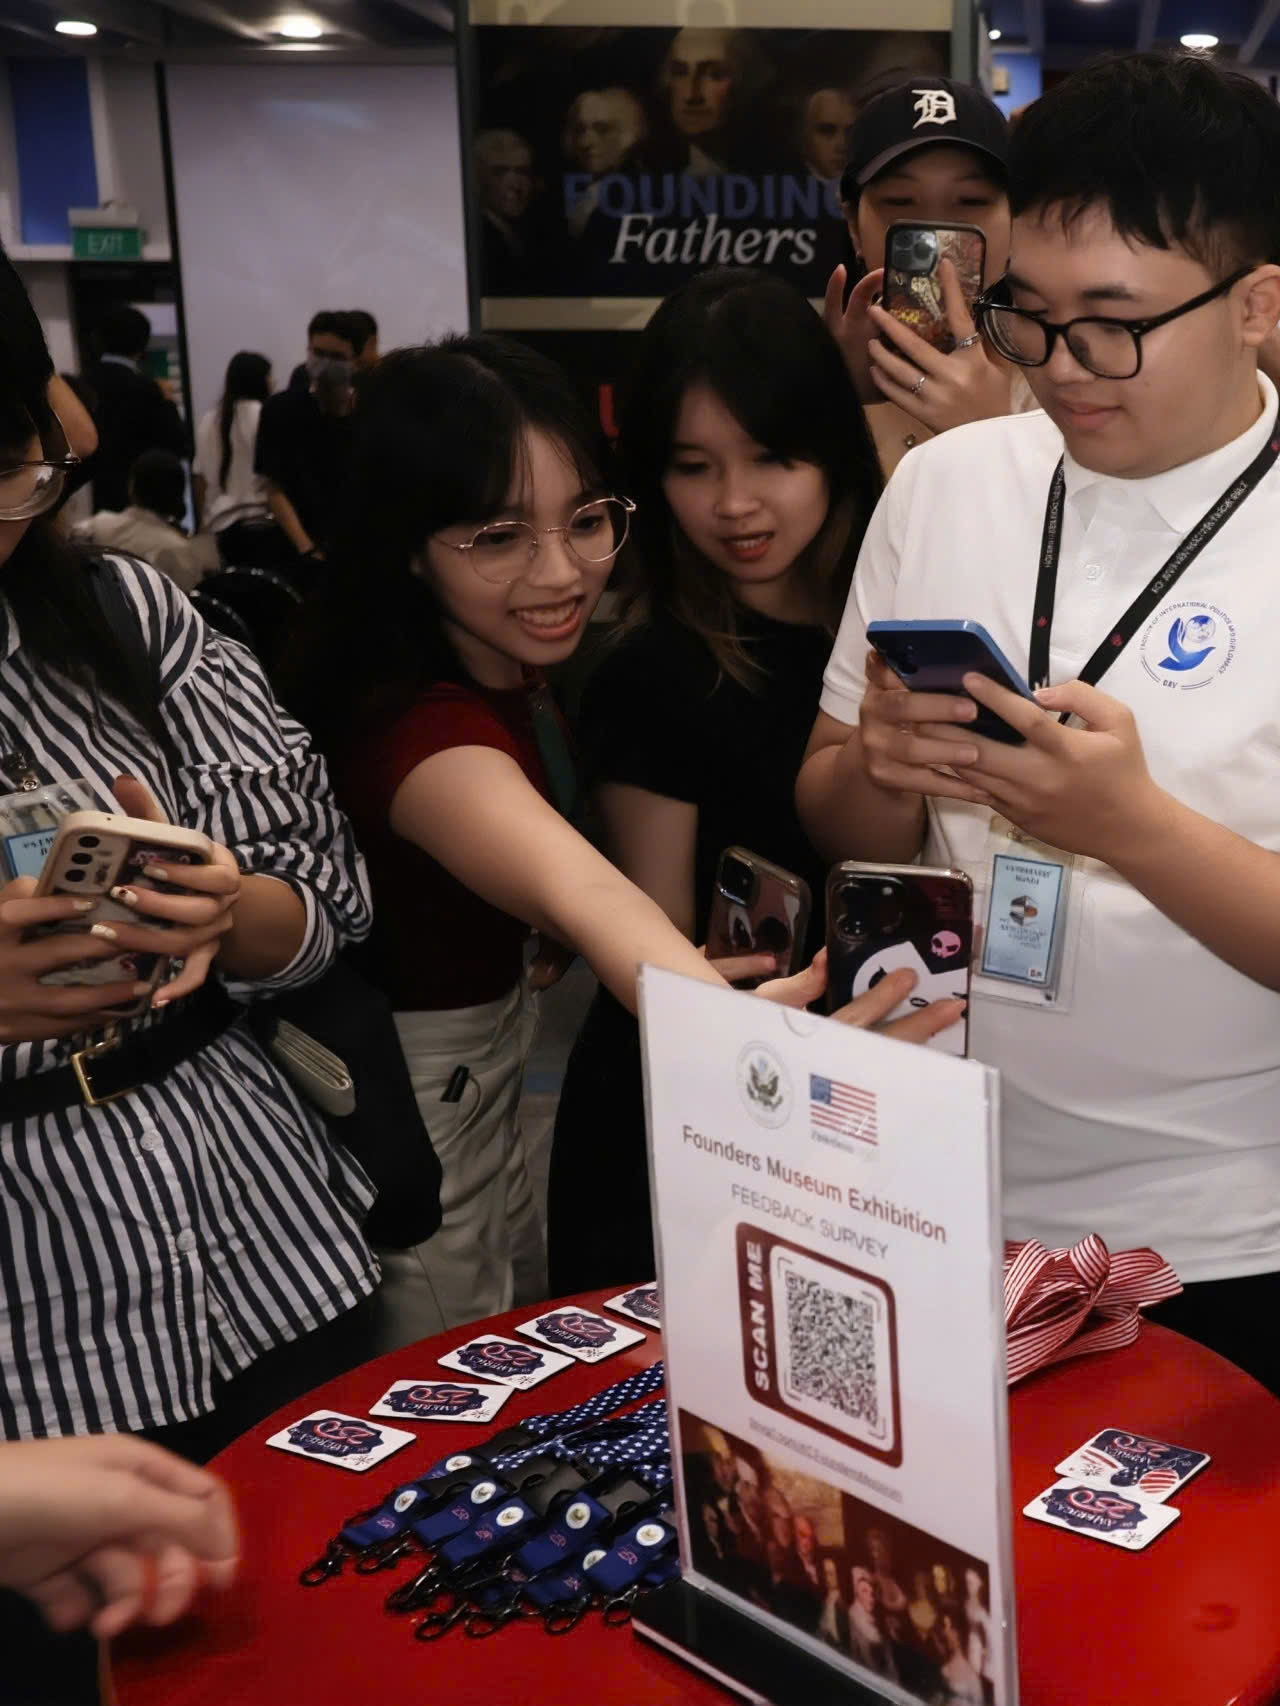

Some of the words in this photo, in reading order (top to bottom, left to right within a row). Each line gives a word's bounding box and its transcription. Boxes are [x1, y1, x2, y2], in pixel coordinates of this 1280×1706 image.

[911, 90, 957, 129] D
[87, 231, 125, 255] EXIT
[608, 213, 817, 264] Fathers
[682, 1125, 762, 1172] Founders
[767, 1156, 842, 1203] Museum
[848, 1188, 947, 1244] Exhibition
[731, 1184, 815, 1229] FEEDBACK
[819, 1219, 888, 1259] SURVEY
[746, 1241, 764, 1291] ME
[751, 1300, 770, 1391] SCAN
